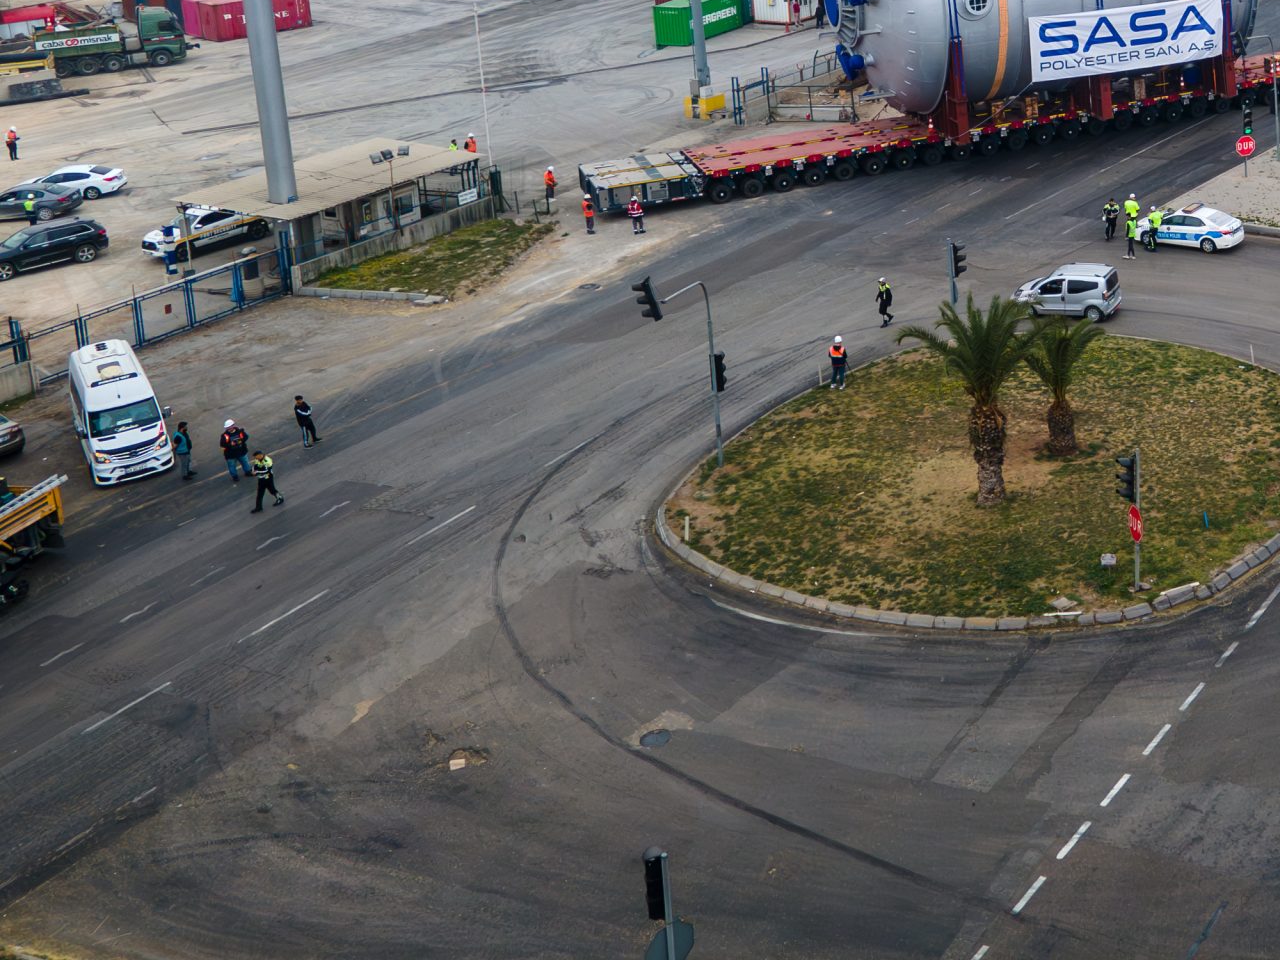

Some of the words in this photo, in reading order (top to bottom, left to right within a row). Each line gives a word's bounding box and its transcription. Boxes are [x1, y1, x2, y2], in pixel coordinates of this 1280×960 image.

[1039, 5, 1216, 58] SASA
[1040, 50, 1140, 72] POLYESTER
[1144, 44, 1184, 60] SAN.
[1188, 40, 1218, 53] A.Ş.
[1238, 141, 1253, 150] DUR
